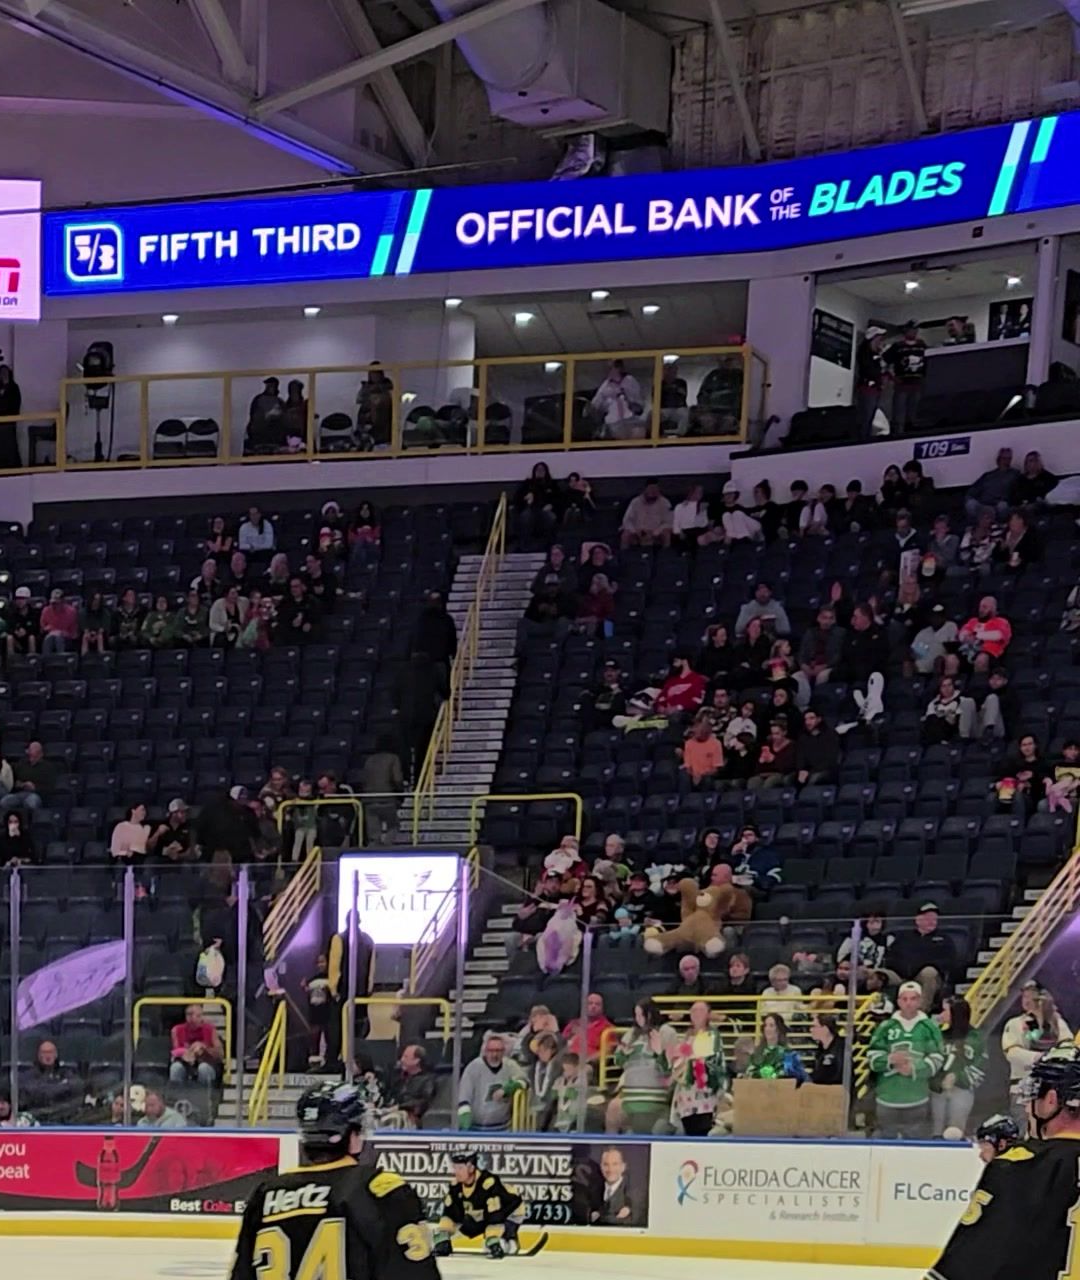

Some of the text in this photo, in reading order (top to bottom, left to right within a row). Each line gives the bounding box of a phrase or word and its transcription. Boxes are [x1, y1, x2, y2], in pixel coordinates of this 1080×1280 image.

[770, 188, 794, 205] OF
[808, 161, 965, 217] BLADES
[455, 193, 761, 246] OFFICIAL BANK
[770, 203, 801, 222] THE
[138, 230, 238, 264] FIFTH
[253, 222, 361, 257] THIRD
[920, 441, 949, 458] 109
[376, 1152, 452, 1173] ANIDJA
[491, 1153, 573, 1176] LEVINE
[703, 1166, 860, 1189] FLORIDA CANCER
[263, 1183, 332, 1216] Hertz
[702, 1193, 860, 1207] SPECIALISTS
[894, 1183, 969, 1202] FLCanc
[170, 1198, 201, 1211] Best
